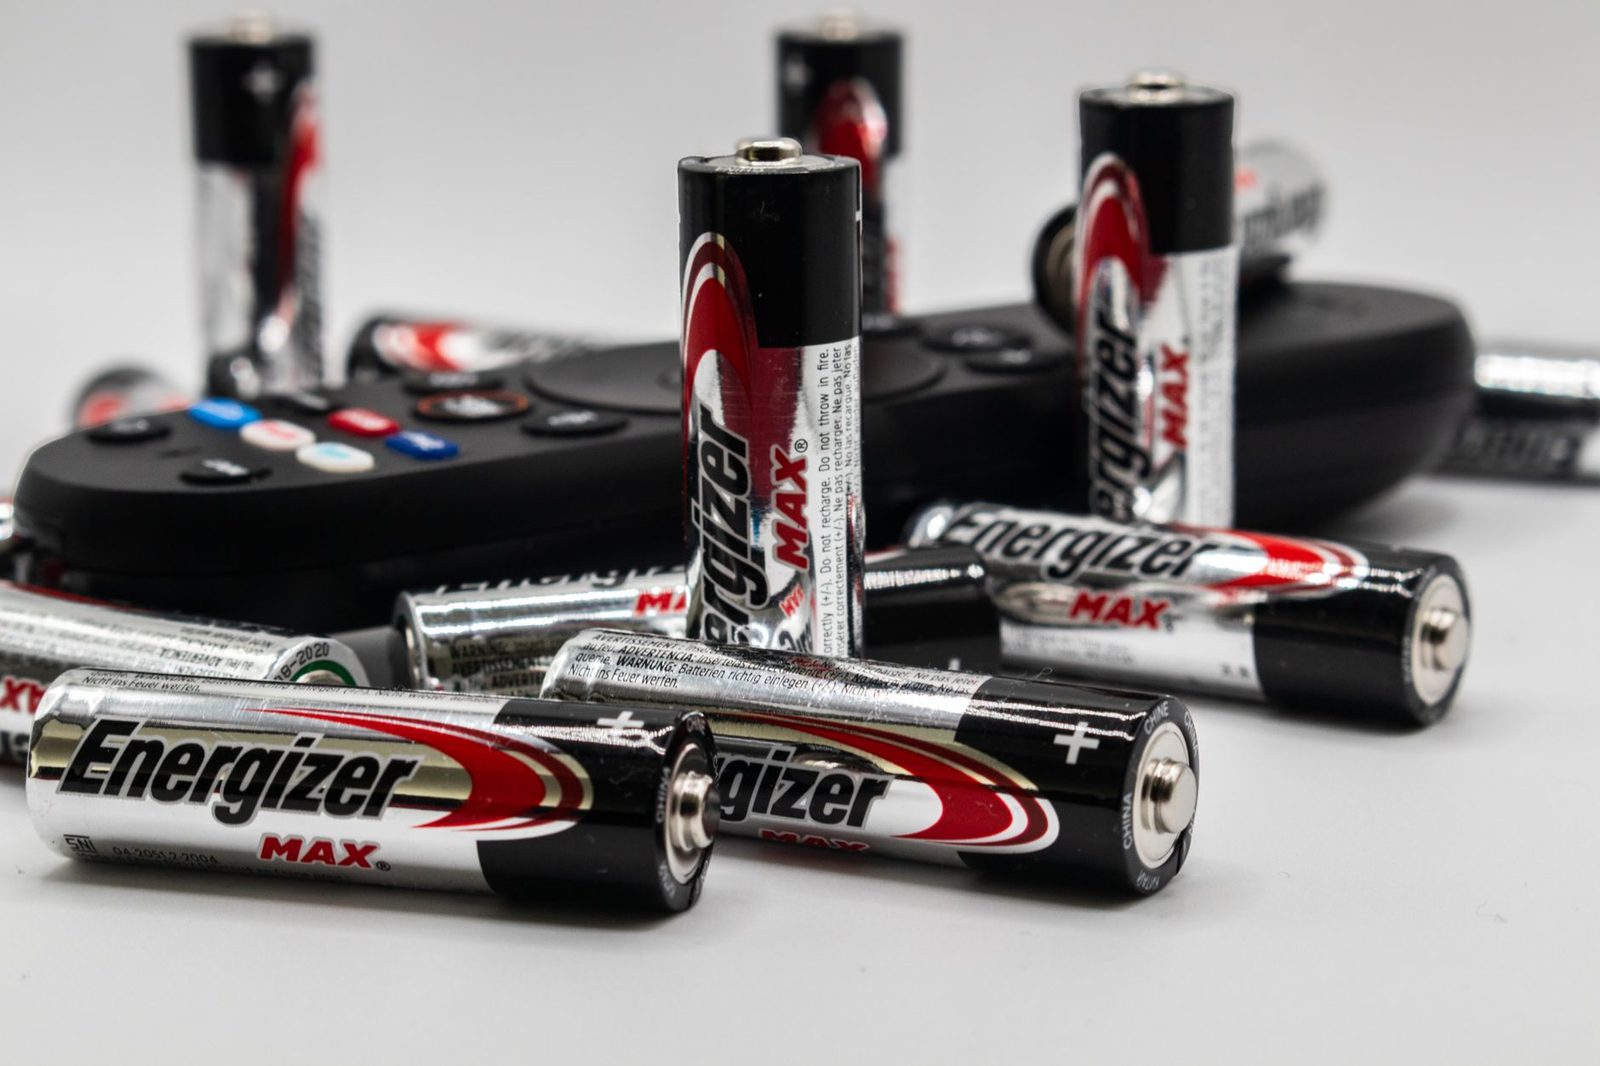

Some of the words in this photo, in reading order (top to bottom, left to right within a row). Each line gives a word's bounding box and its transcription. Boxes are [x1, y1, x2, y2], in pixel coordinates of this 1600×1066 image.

[816, 348, 829, 371] fire.
[831, 347, 843, 373] jeter
[817, 376, 829, 388] in
[833, 375, 843, 395] pas
[1159, 342, 1190, 449] MAX
[817, 393, 830, 427] throw
[831, 398, 842, 414] Ne
[818, 431, 830, 451] not
[818, 456, 831, 472] Do
[834, 474, 844, 494] pas
[819, 477, 832, 529] recharge.
[833, 497, 843, 512] Ne
[820, 534, 832, 553] not
[946, 504, 1216, 581] Energizer
[820, 558, 832, 574] Do
[834, 545, 845, 617] correctement
[1069, 590, 1170, 629] MAX
[821, 612, 834, 656] orrectly
[568, 663, 594, 677] Nicht
[595, 667, 610, 680] ins
[611, 668, 639, 684] Feuer
[641, 672, 679, 688] werfen.
[616, 655, 677, 672] WARNUNG:
[678, 662, 725, 679] Batterien
[727, 670, 762, 685] richtig
[764, 674, 808, 690] einlegen
[1143, 700, 1169, 734] CHINE
[56, 717, 421, 827] Energizer
[716, 743, 895, 830] gizer
[1121, 791, 1132, 850] CHINA
